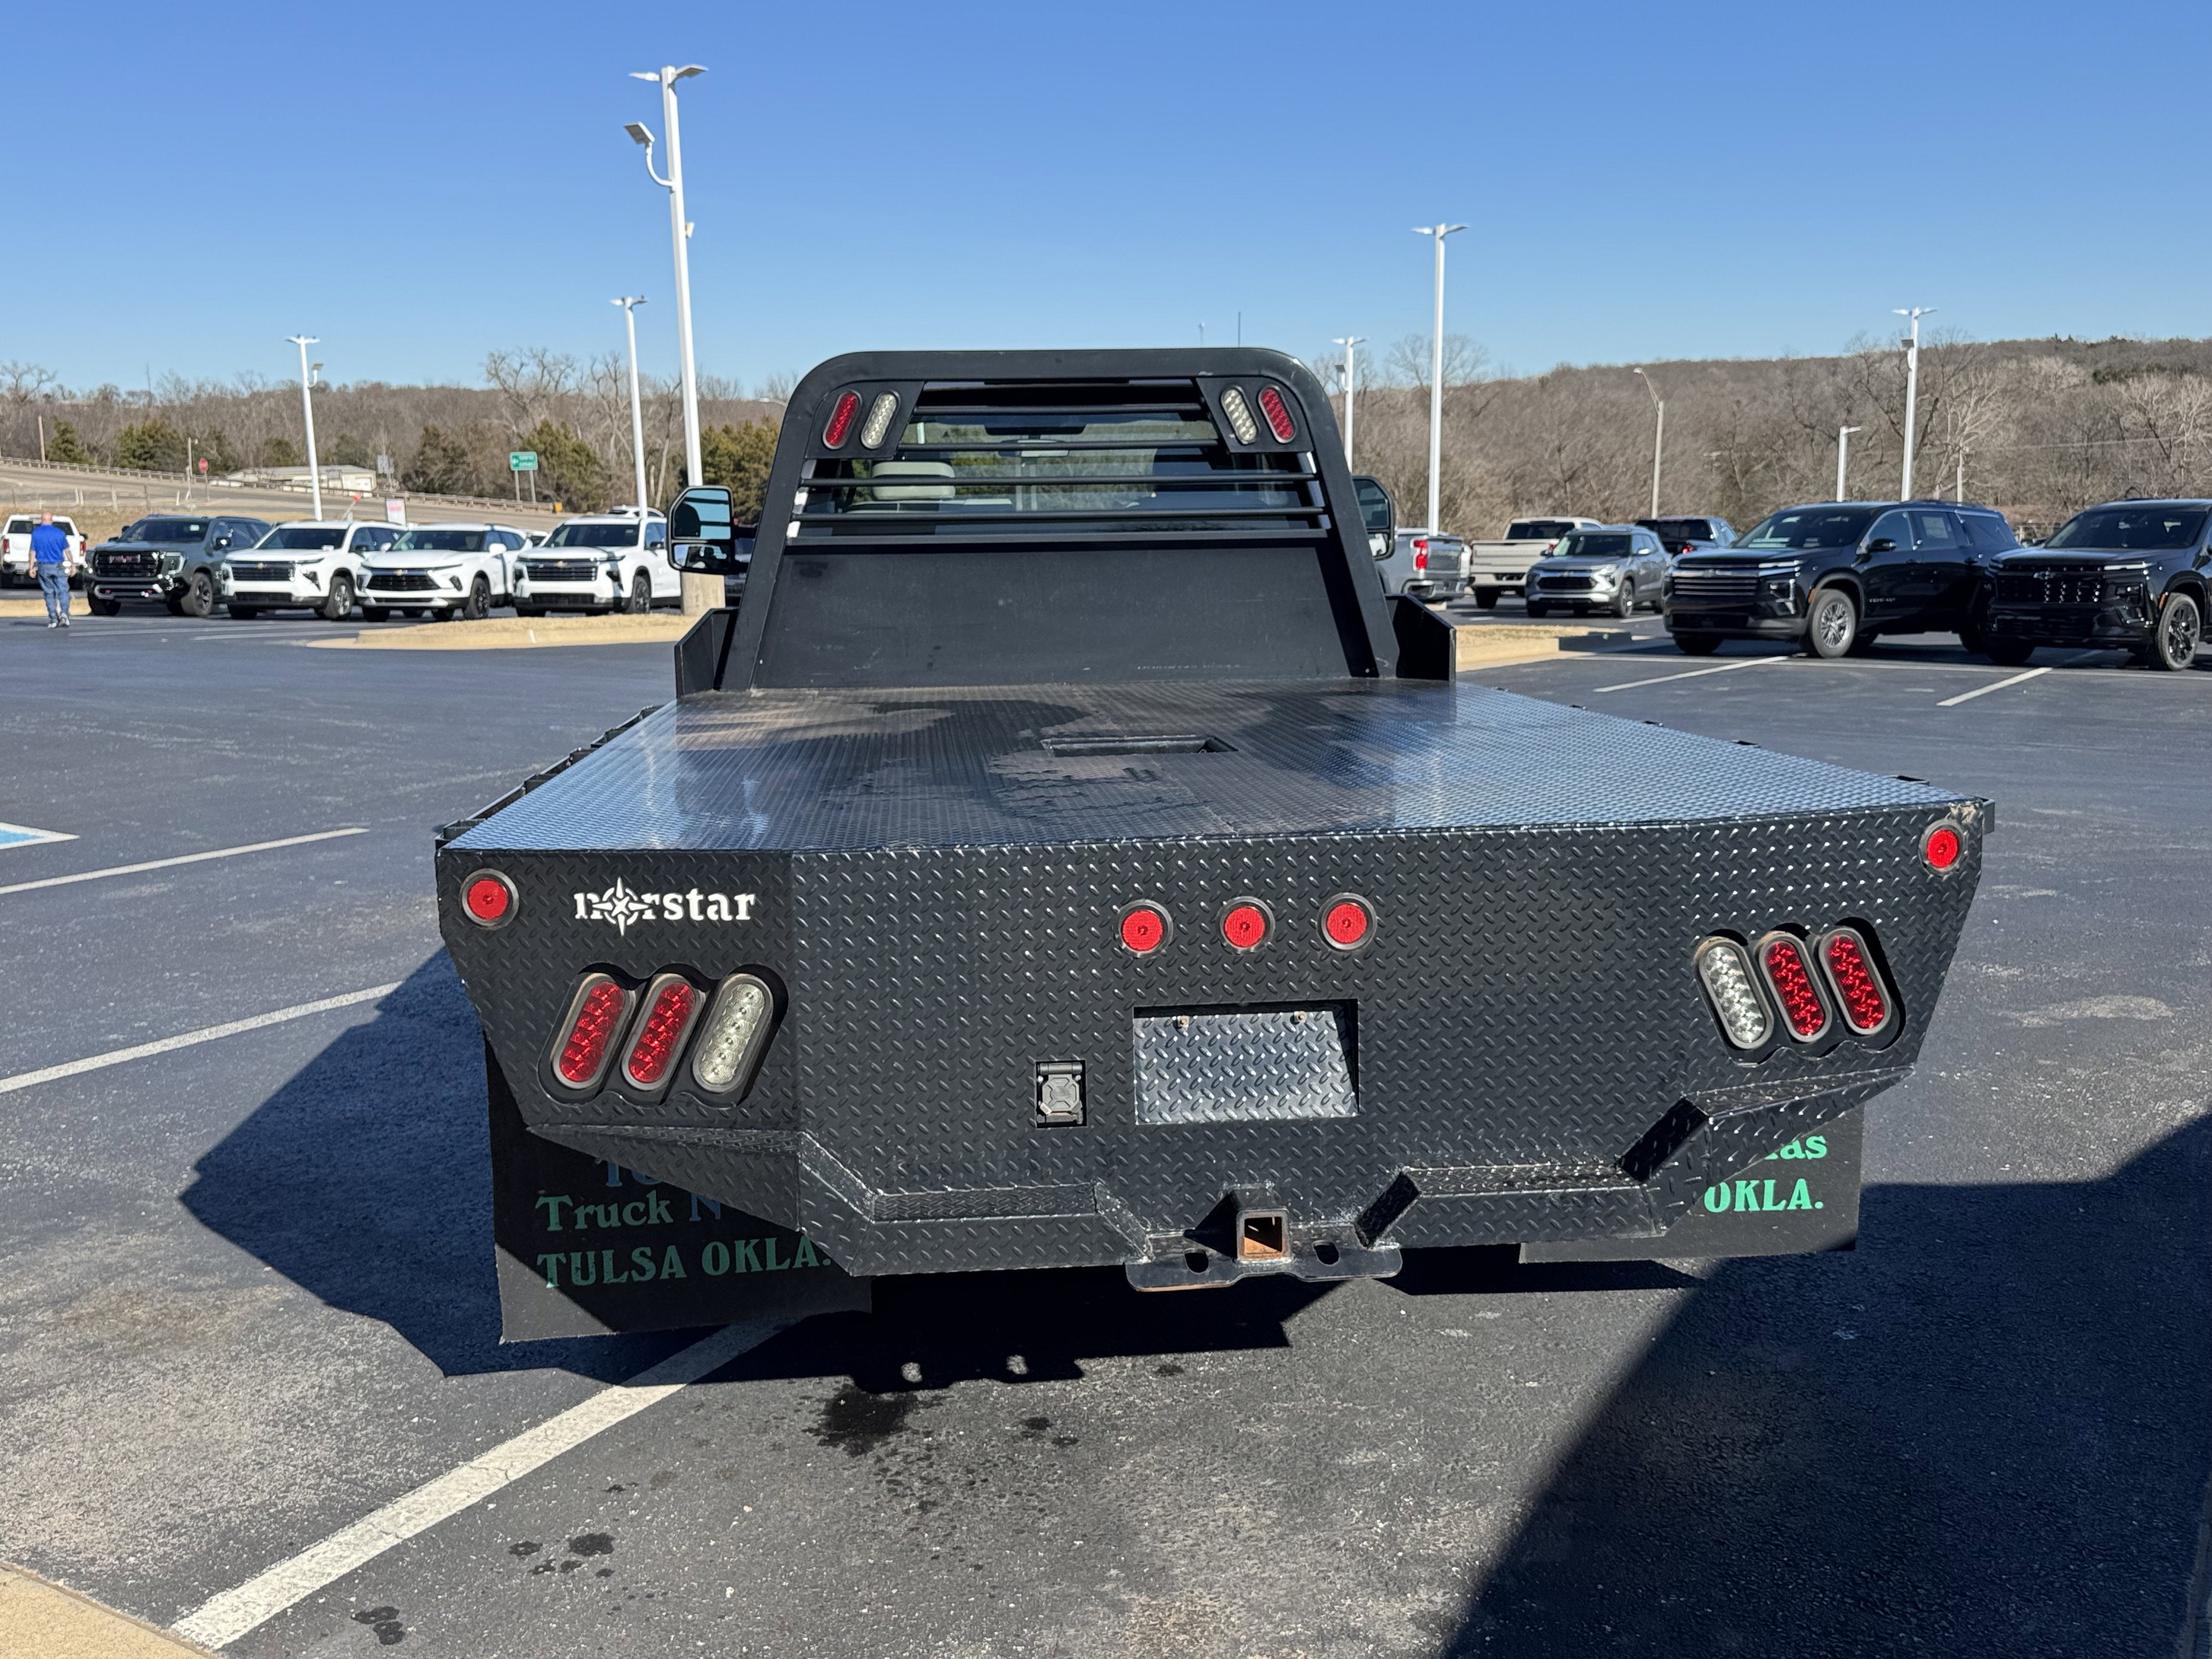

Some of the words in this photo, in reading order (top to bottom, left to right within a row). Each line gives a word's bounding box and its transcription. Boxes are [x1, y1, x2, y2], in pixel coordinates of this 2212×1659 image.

[535, 1189, 674, 1231] Truck
[1704, 1178, 1824, 1213] OKLA.
[537, 1245, 685, 1288] TULSA
[701, 1236, 831, 1276] OKLA.
